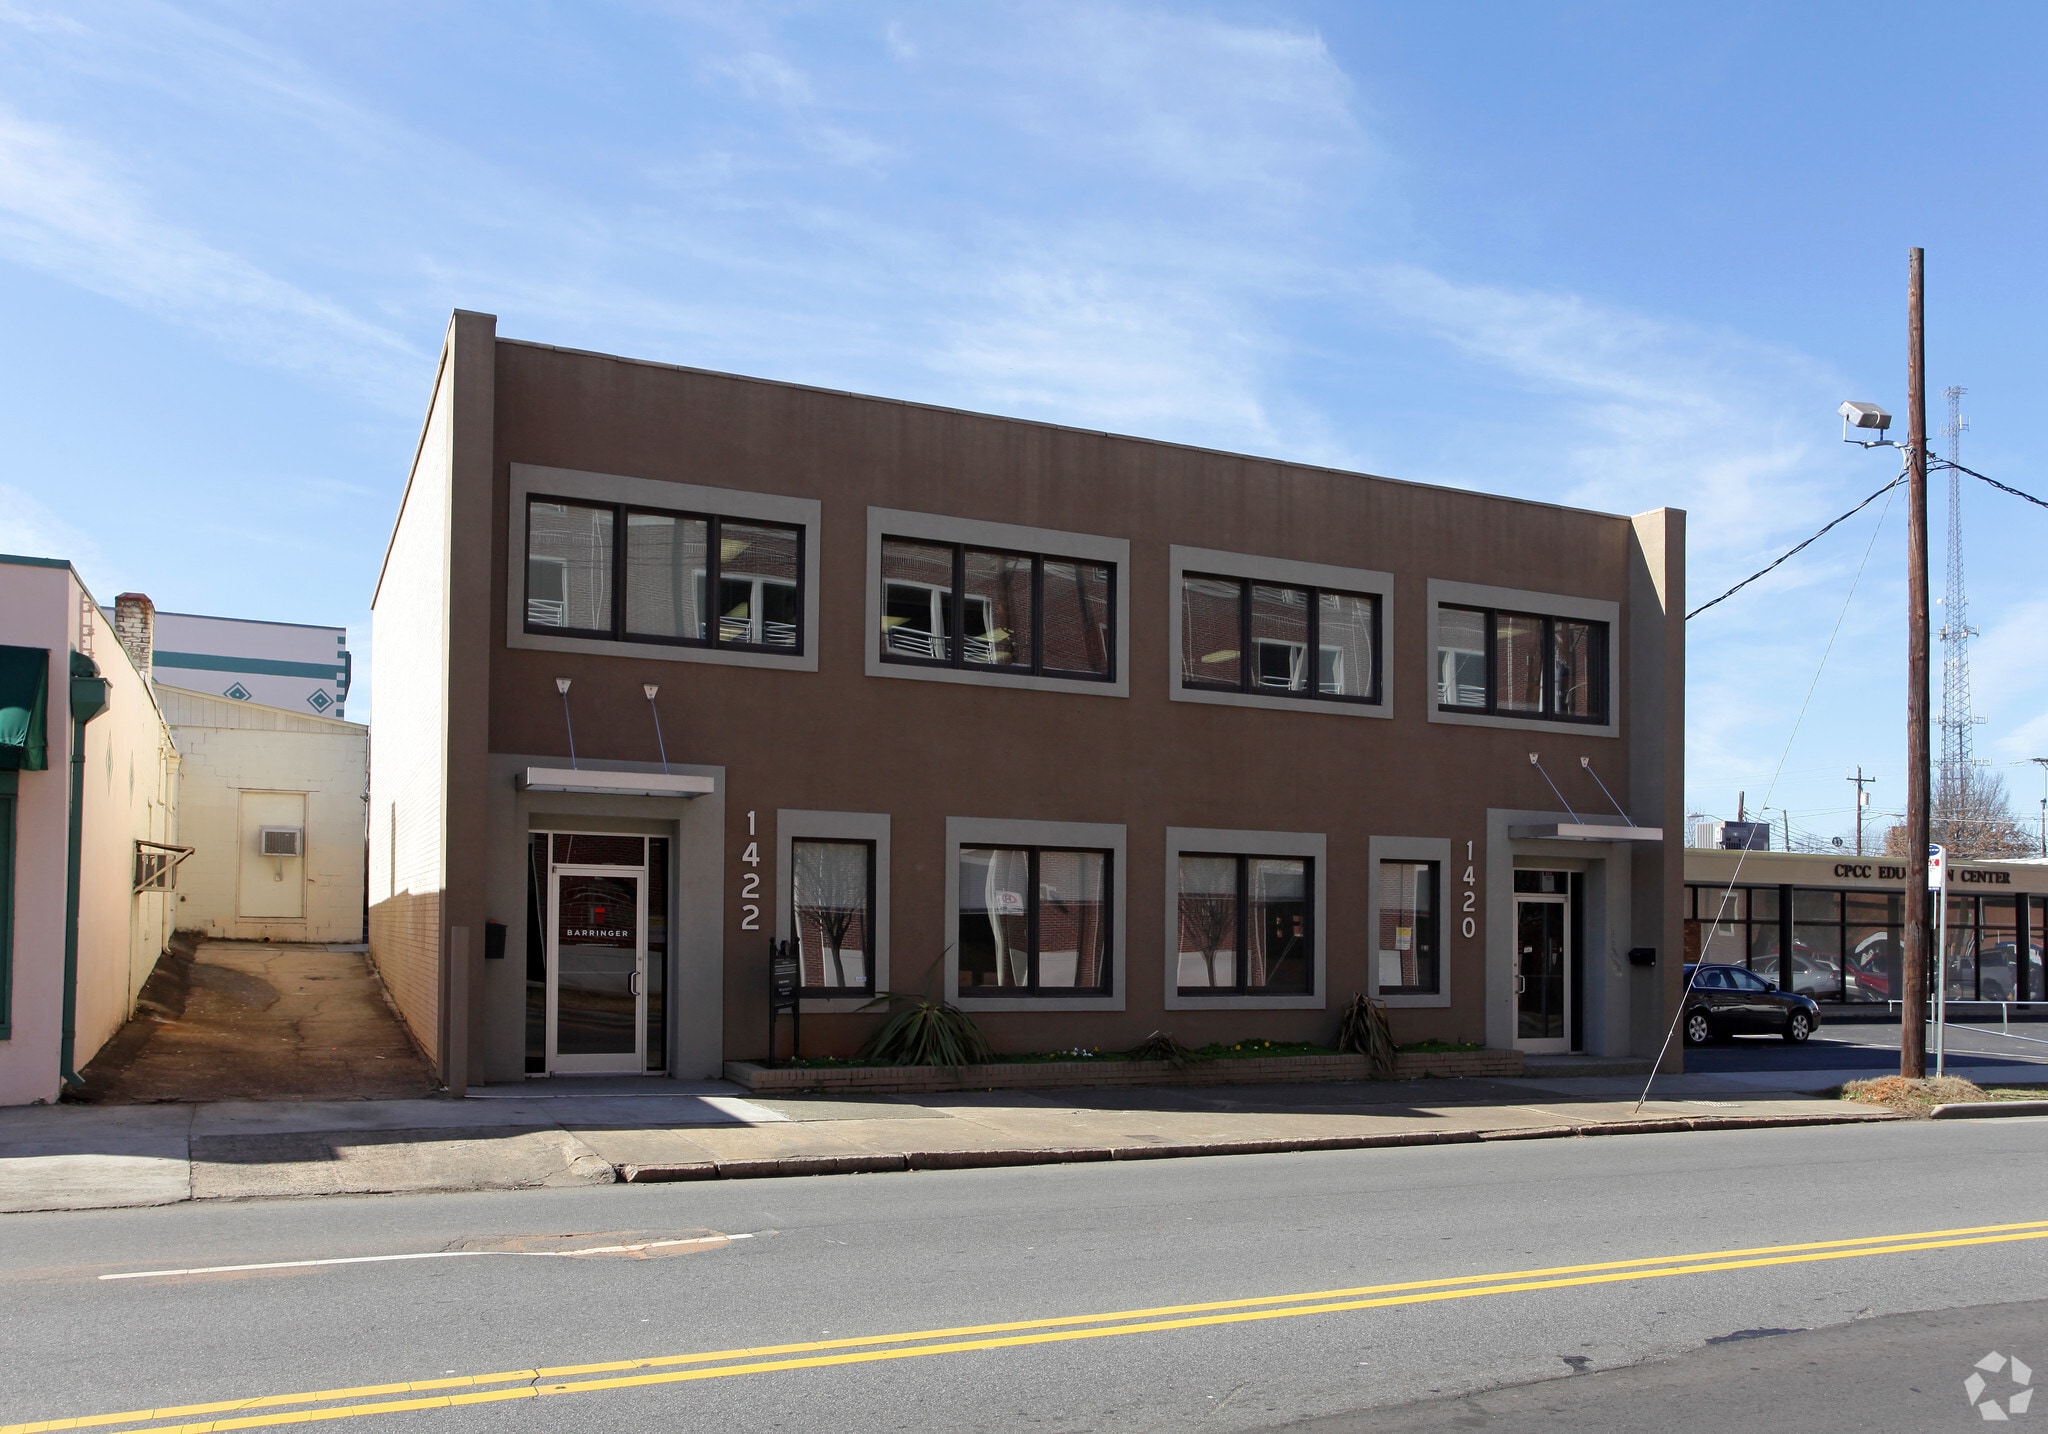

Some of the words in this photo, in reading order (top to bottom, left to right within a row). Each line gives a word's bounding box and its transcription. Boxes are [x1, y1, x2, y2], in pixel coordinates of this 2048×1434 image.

[741, 810, 760, 931] 1422
[1462, 840, 1476, 939] 1420
[1834, 863, 1872, 879] CPCC
[1961, 869, 2011, 885] CENTER
[566, 929, 629, 938] BARRINGER
